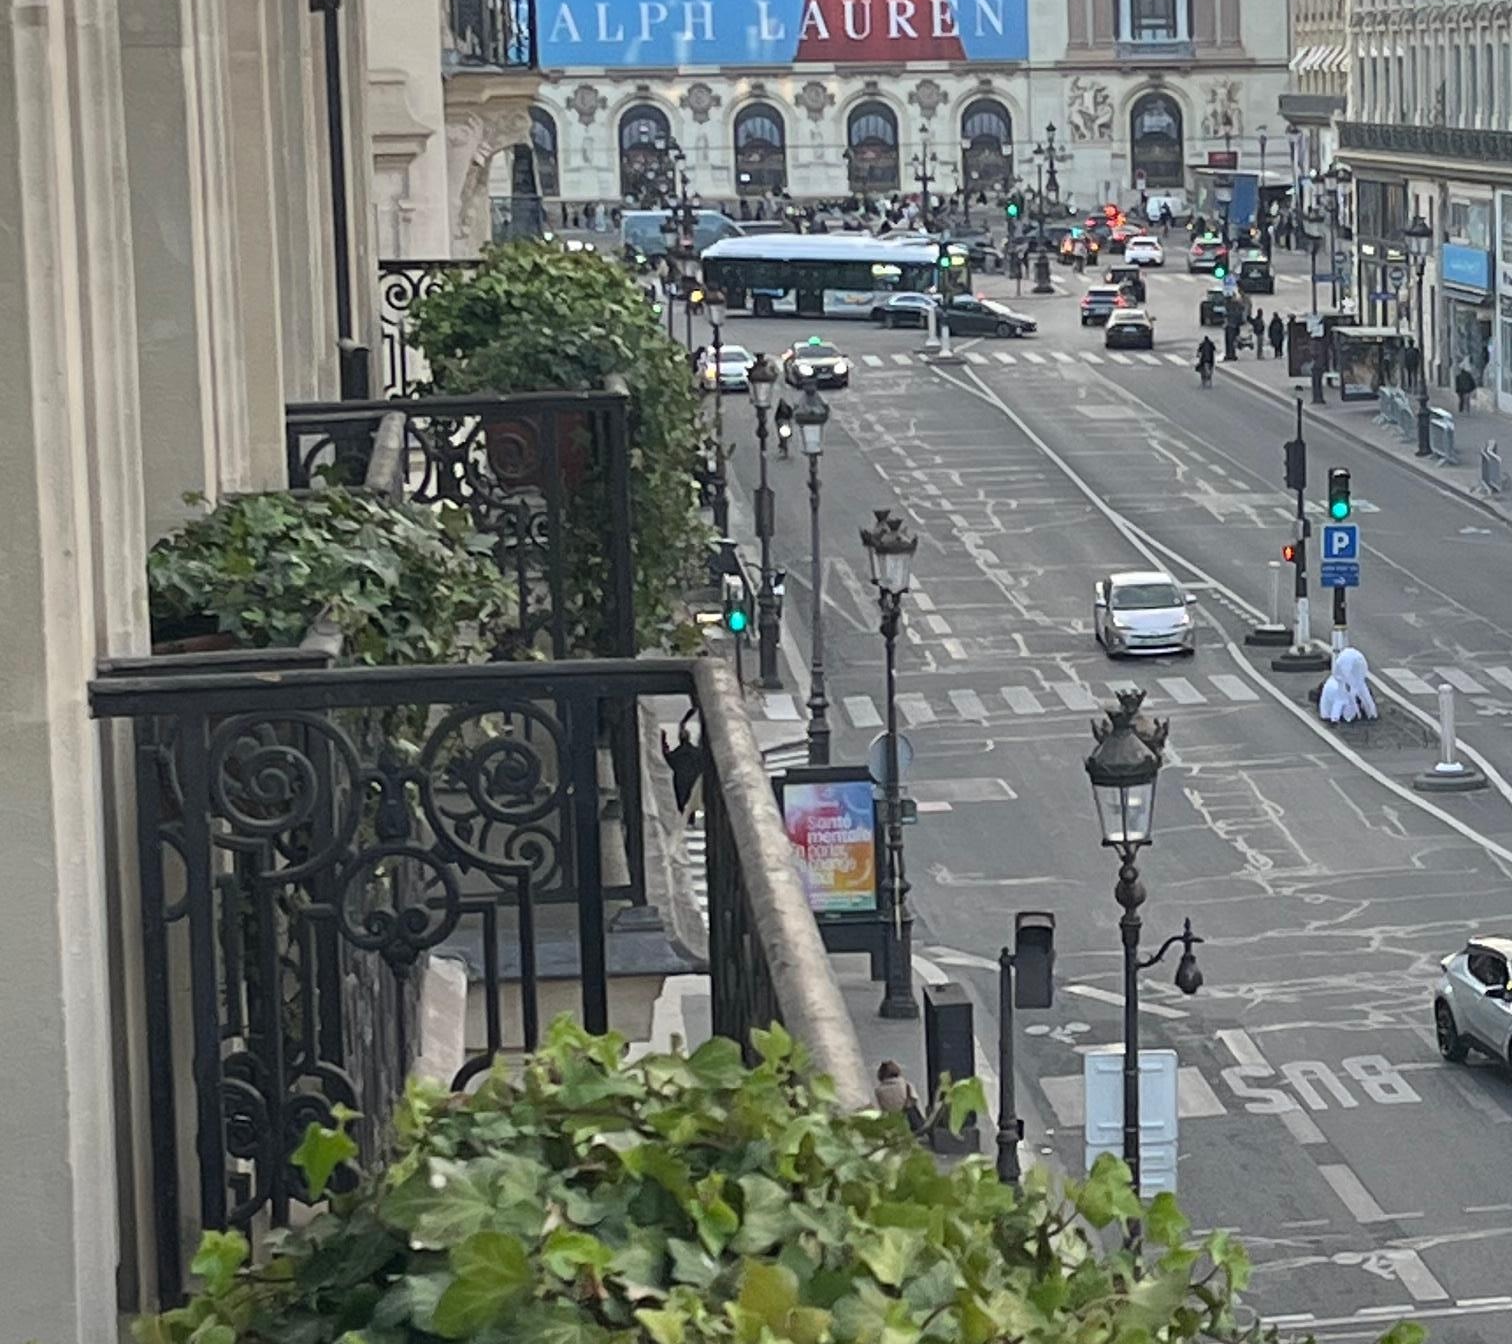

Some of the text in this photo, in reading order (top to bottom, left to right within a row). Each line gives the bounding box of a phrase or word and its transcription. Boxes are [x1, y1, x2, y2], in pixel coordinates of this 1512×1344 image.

[1332, 531, 1349, 555] P
[807, 812, 852, 830] Santé
[1221, 1054, 1422, 1114] BUS
